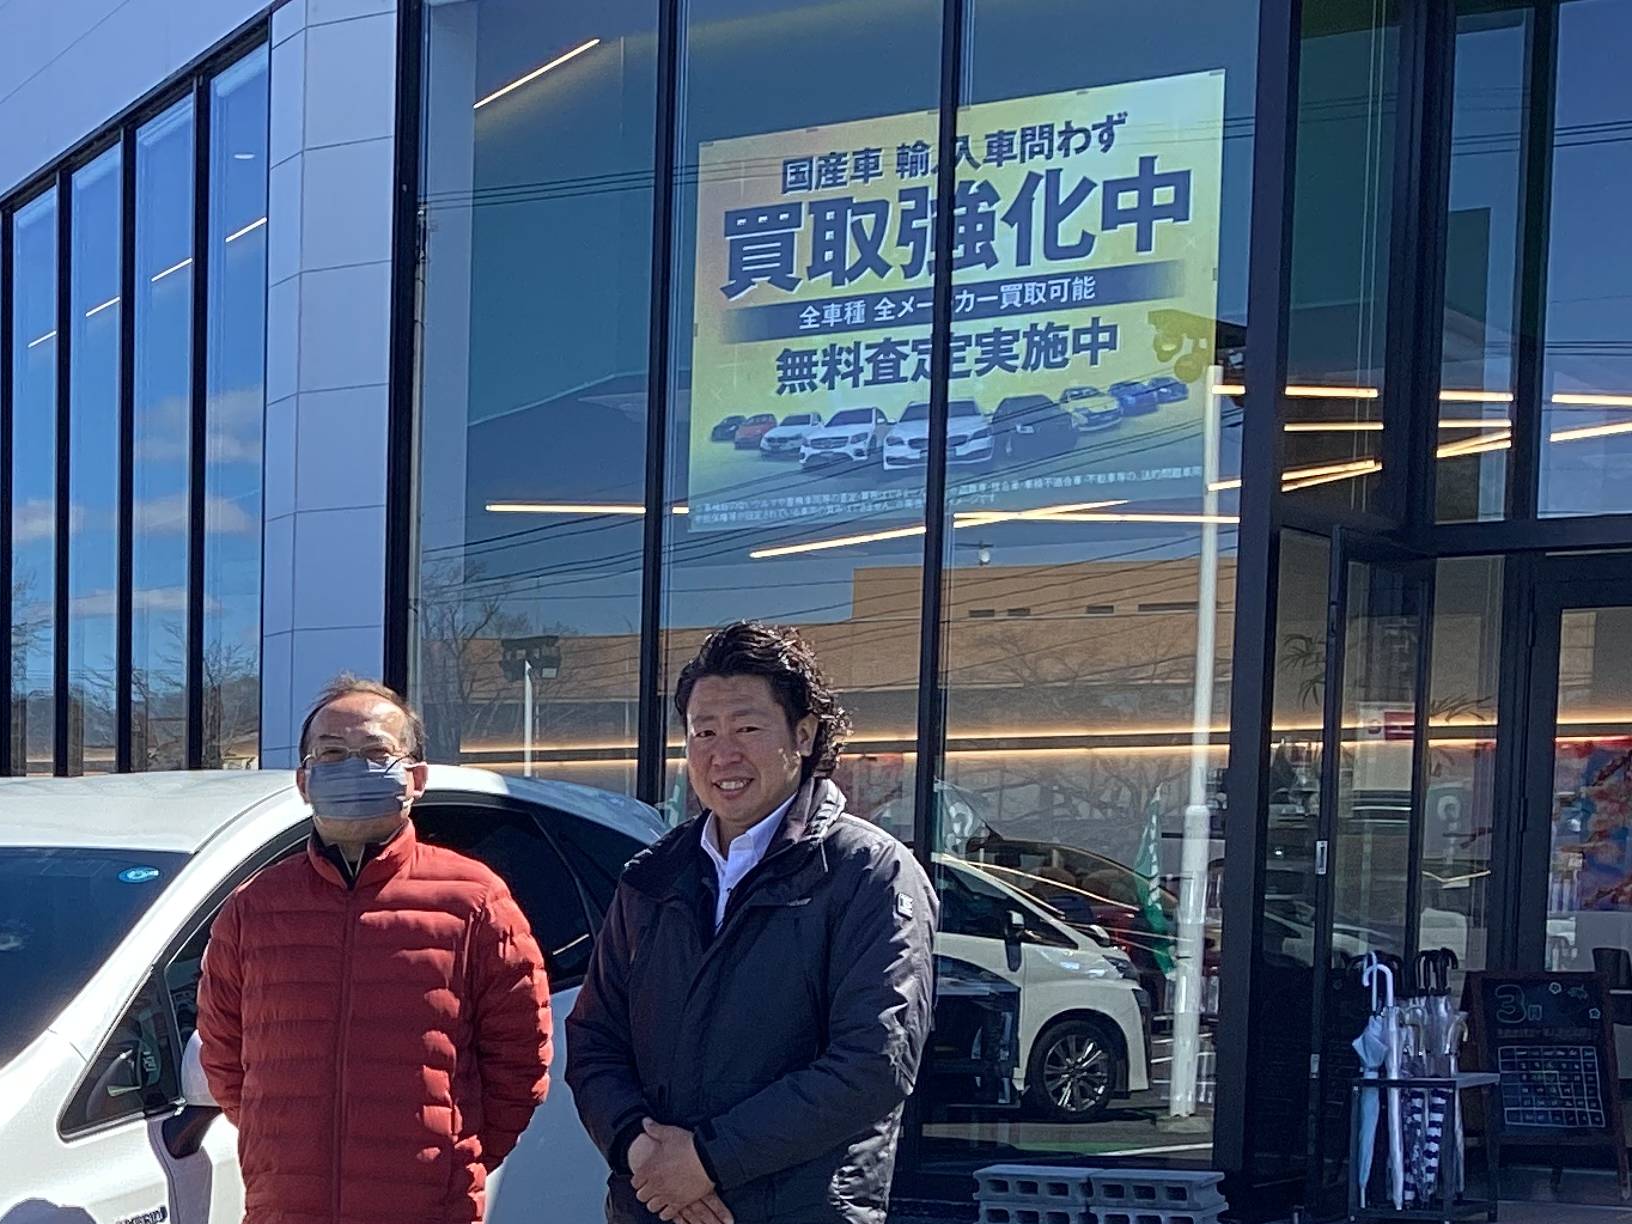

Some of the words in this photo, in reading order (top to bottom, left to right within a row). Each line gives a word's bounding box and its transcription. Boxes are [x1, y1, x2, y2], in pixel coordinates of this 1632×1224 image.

[782, 148, 884, 194] 国産車
[896, 111, 1128, 178] 輸入車問わず
[720, 155, 1191, 299] 買取強化中
[799, 299, 866, 330] 全車種
[874, 276, 1096, 322] 全メーカー買取可能
[776, 316, 1118, 395] 無料査定実施中
